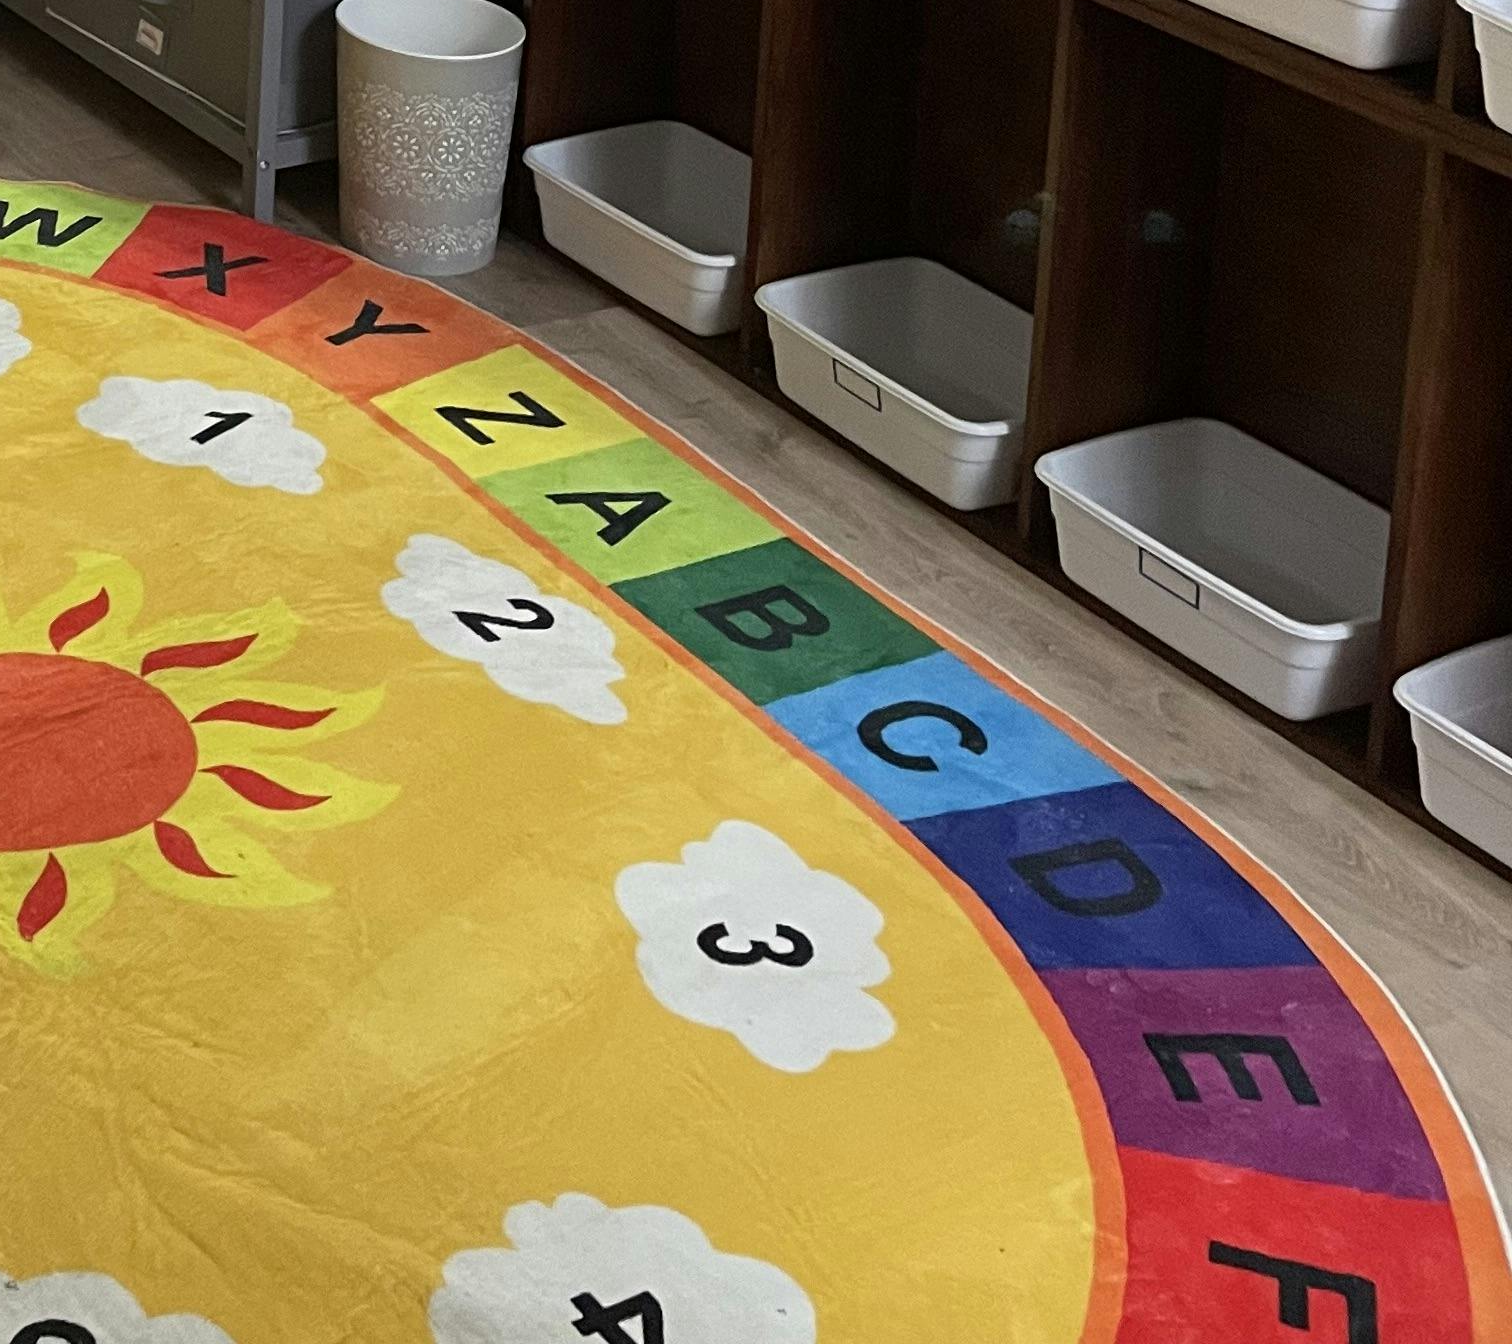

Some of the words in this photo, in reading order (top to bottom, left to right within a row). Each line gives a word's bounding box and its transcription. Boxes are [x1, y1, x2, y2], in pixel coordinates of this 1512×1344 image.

[150, 242, 268, 297] X
[326, 299, 429, 346] Y
[190, 411, 253, 445] 1
[435, 390, 566, 446] Z
[545, 490, 672, 547] A
[452, 598, 555, 643] 2
[691, 582, 831, 653] B
[856, 700, 988, 772] C
[1005, 835, 1165, 919] D
[696, 922, 814, 967] 3
[1140, 1030, 1322, 1109] E
[1208, 1240, 1378, 1344] F
